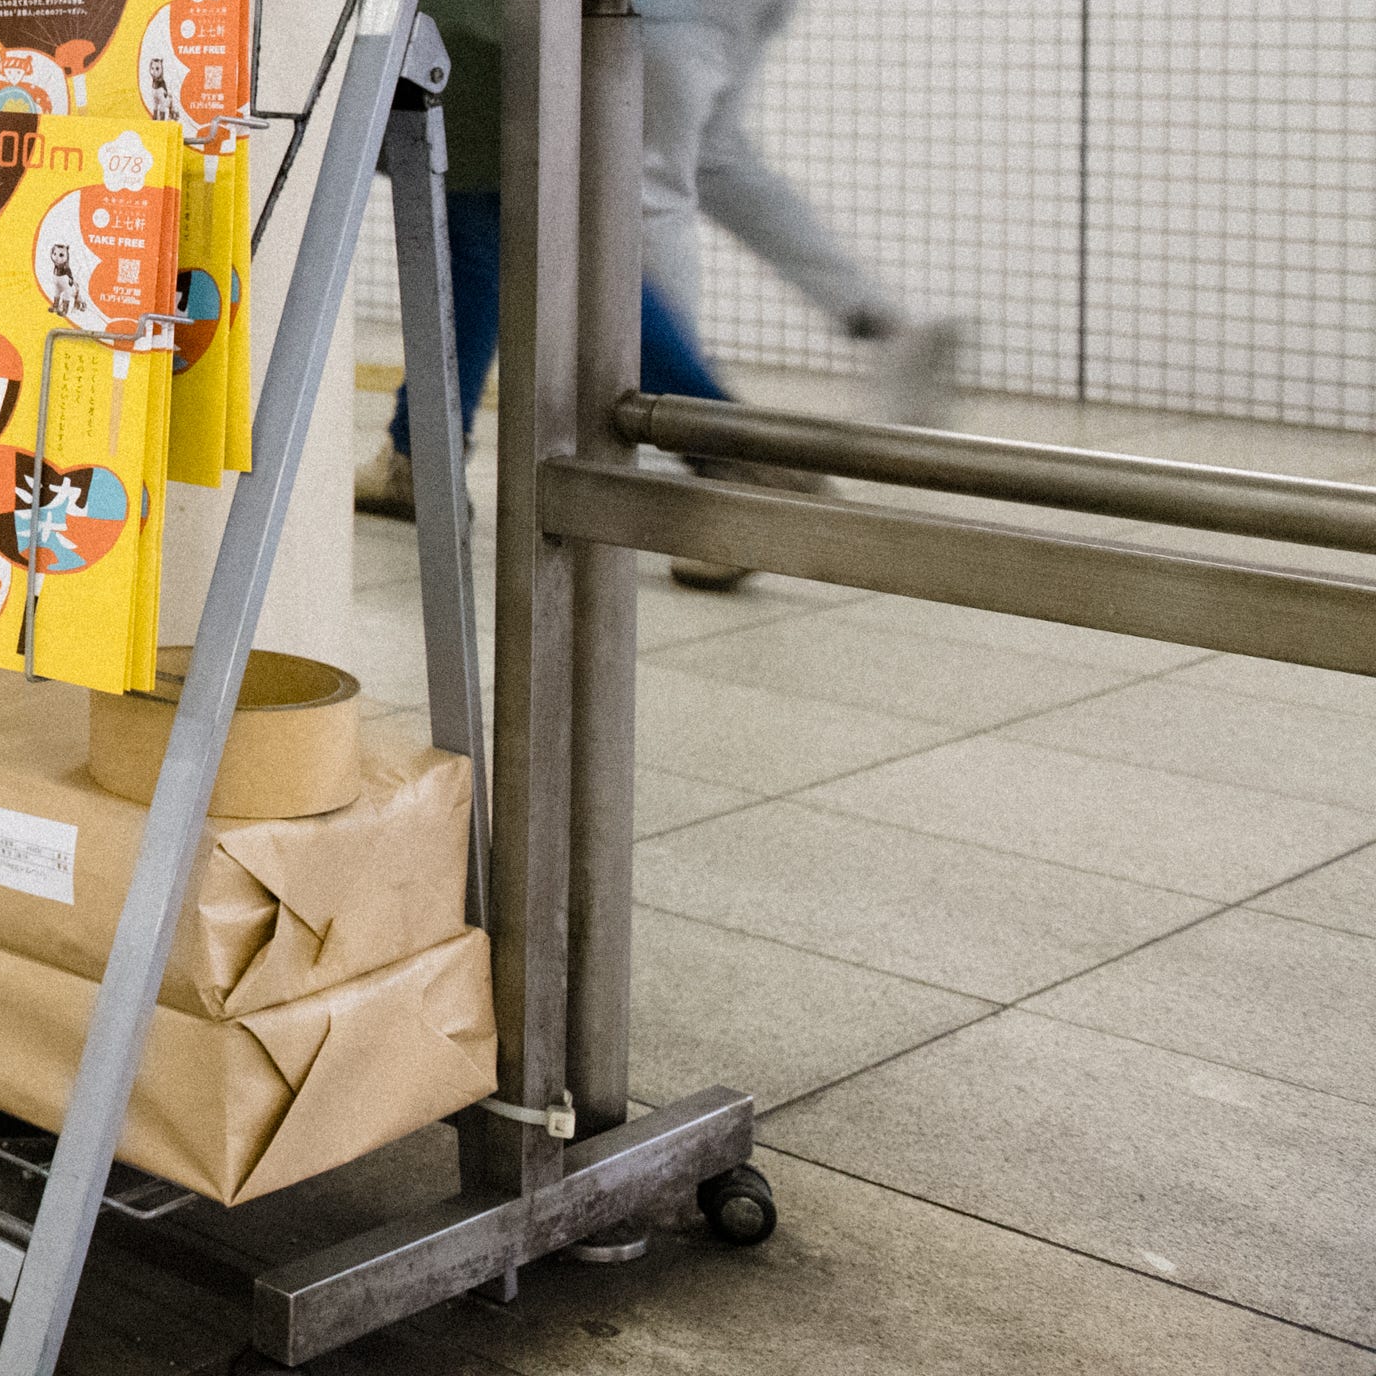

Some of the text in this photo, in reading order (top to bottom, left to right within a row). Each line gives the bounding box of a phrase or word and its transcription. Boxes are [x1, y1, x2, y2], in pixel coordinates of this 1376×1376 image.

[177, 45, 226, 55] TAKE FREE
[109, 154, 143, 174] 078
[111, 215, 146, 232] 上七軒
[88, 234, 146, 249] TAKE FREE
